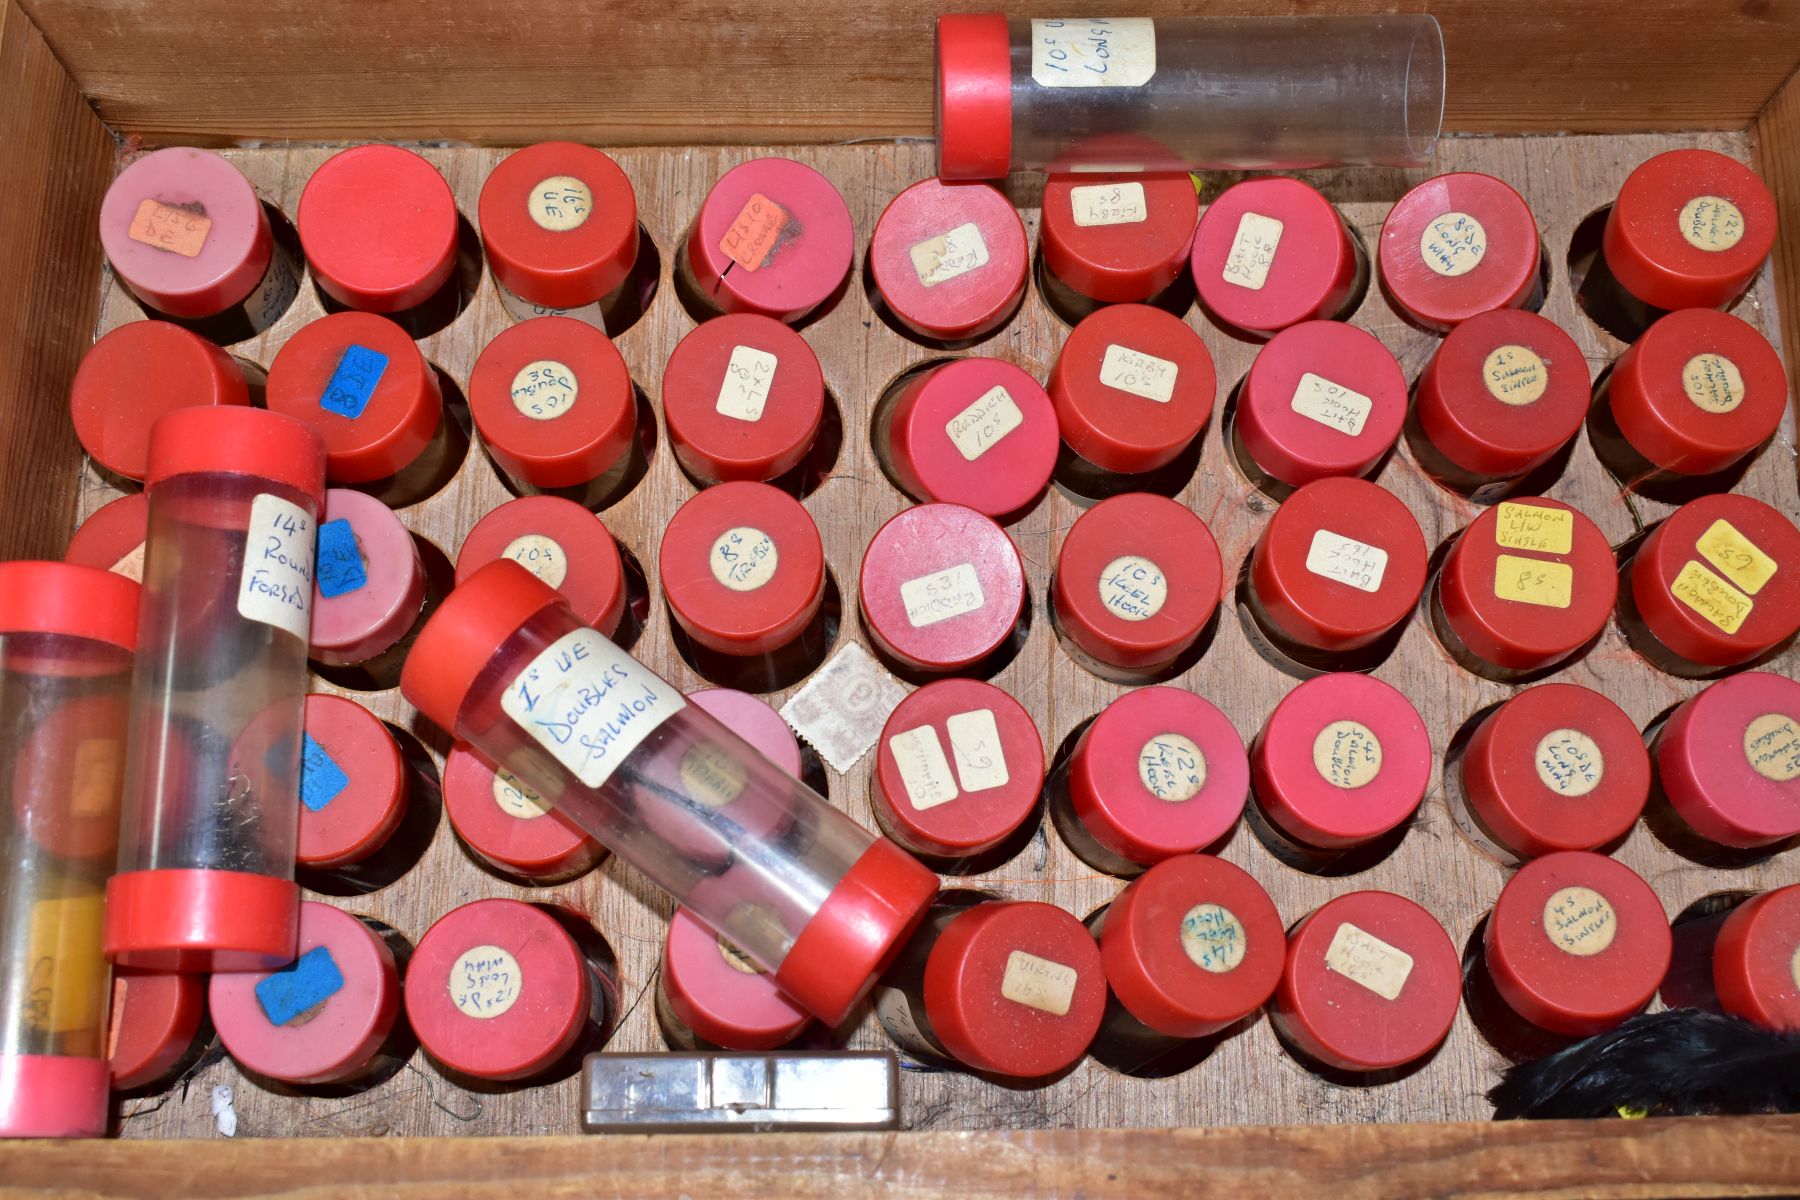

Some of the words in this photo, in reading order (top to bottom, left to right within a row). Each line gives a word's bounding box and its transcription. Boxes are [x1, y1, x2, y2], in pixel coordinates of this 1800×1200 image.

[543, 191, 563, 218] UE
[1503, 505, 1565, 523] SALMON
[579, 682, 658, 760] SALMON
